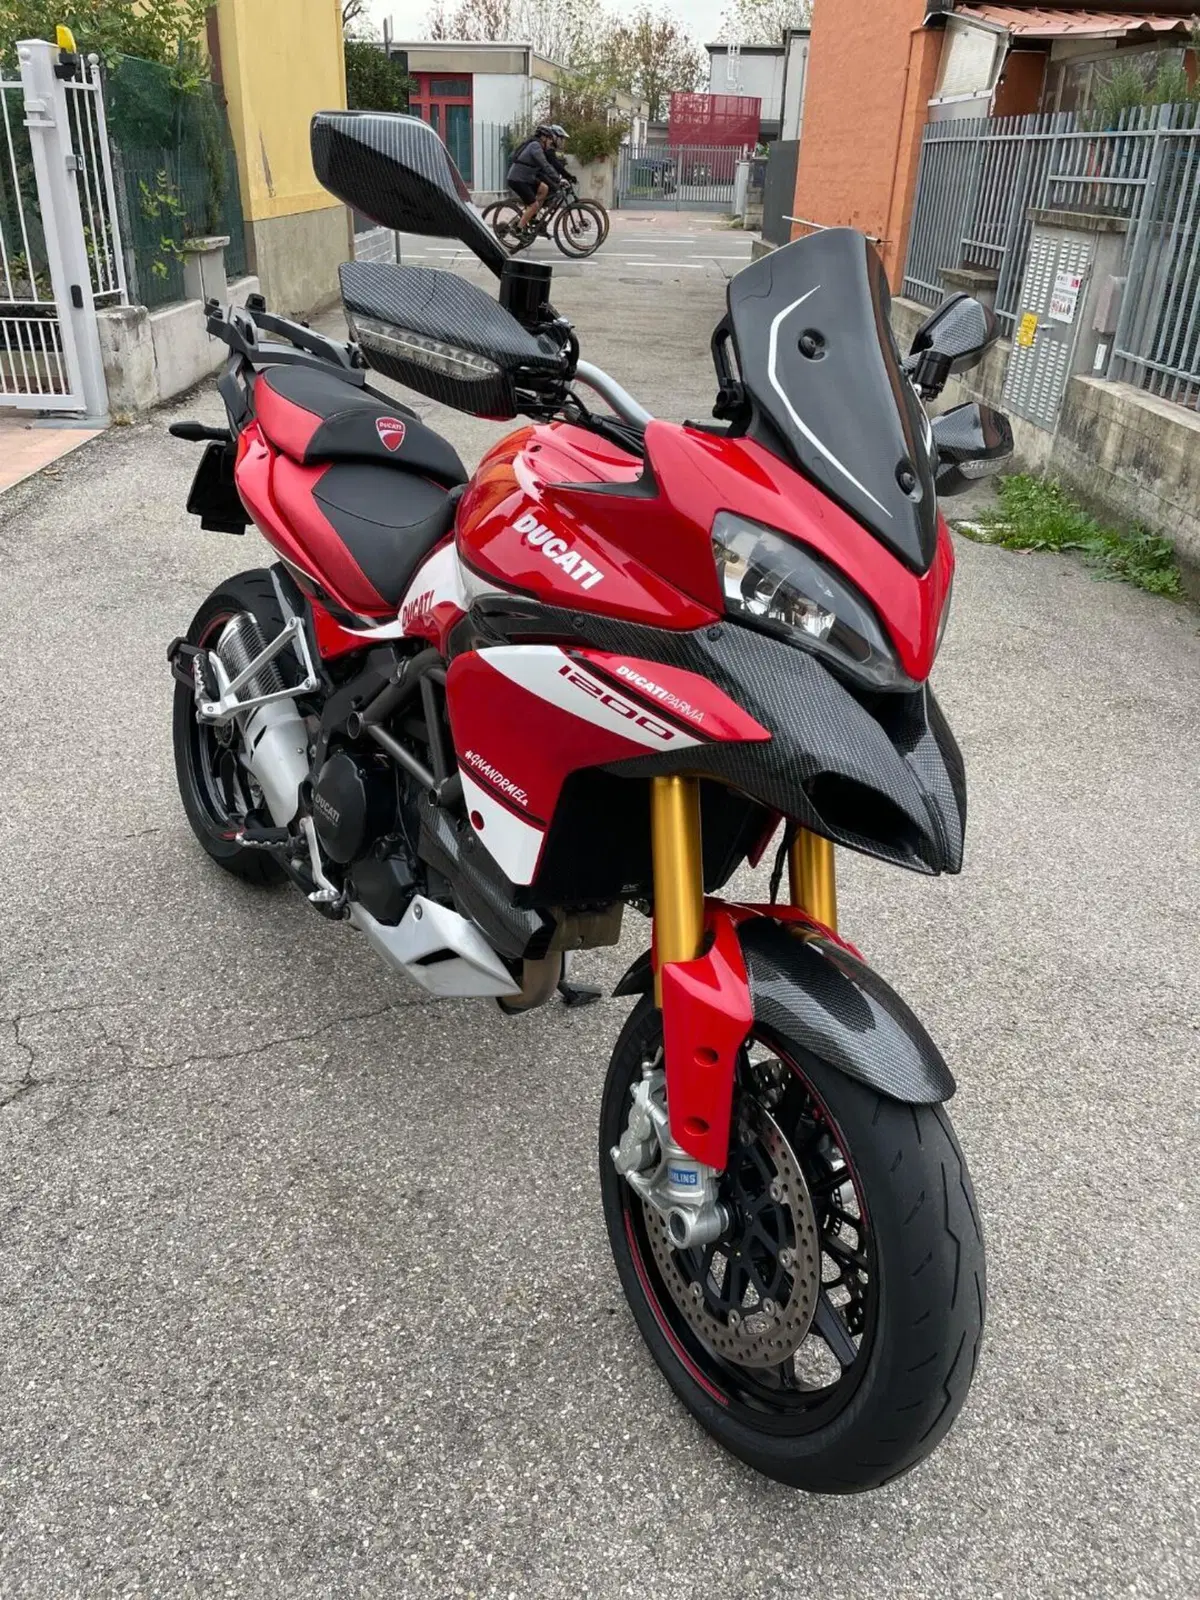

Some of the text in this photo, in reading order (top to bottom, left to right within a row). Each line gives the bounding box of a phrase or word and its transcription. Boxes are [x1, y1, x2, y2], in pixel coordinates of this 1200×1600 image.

[379, 421, 402, 430] DUCATI
[512, 513, 605, 590] DUCATI
[402, 589, 435, 628] DUCATI
[558, 664, 675, 740] 1200
[314, 792, 340, 822] DUCATI
